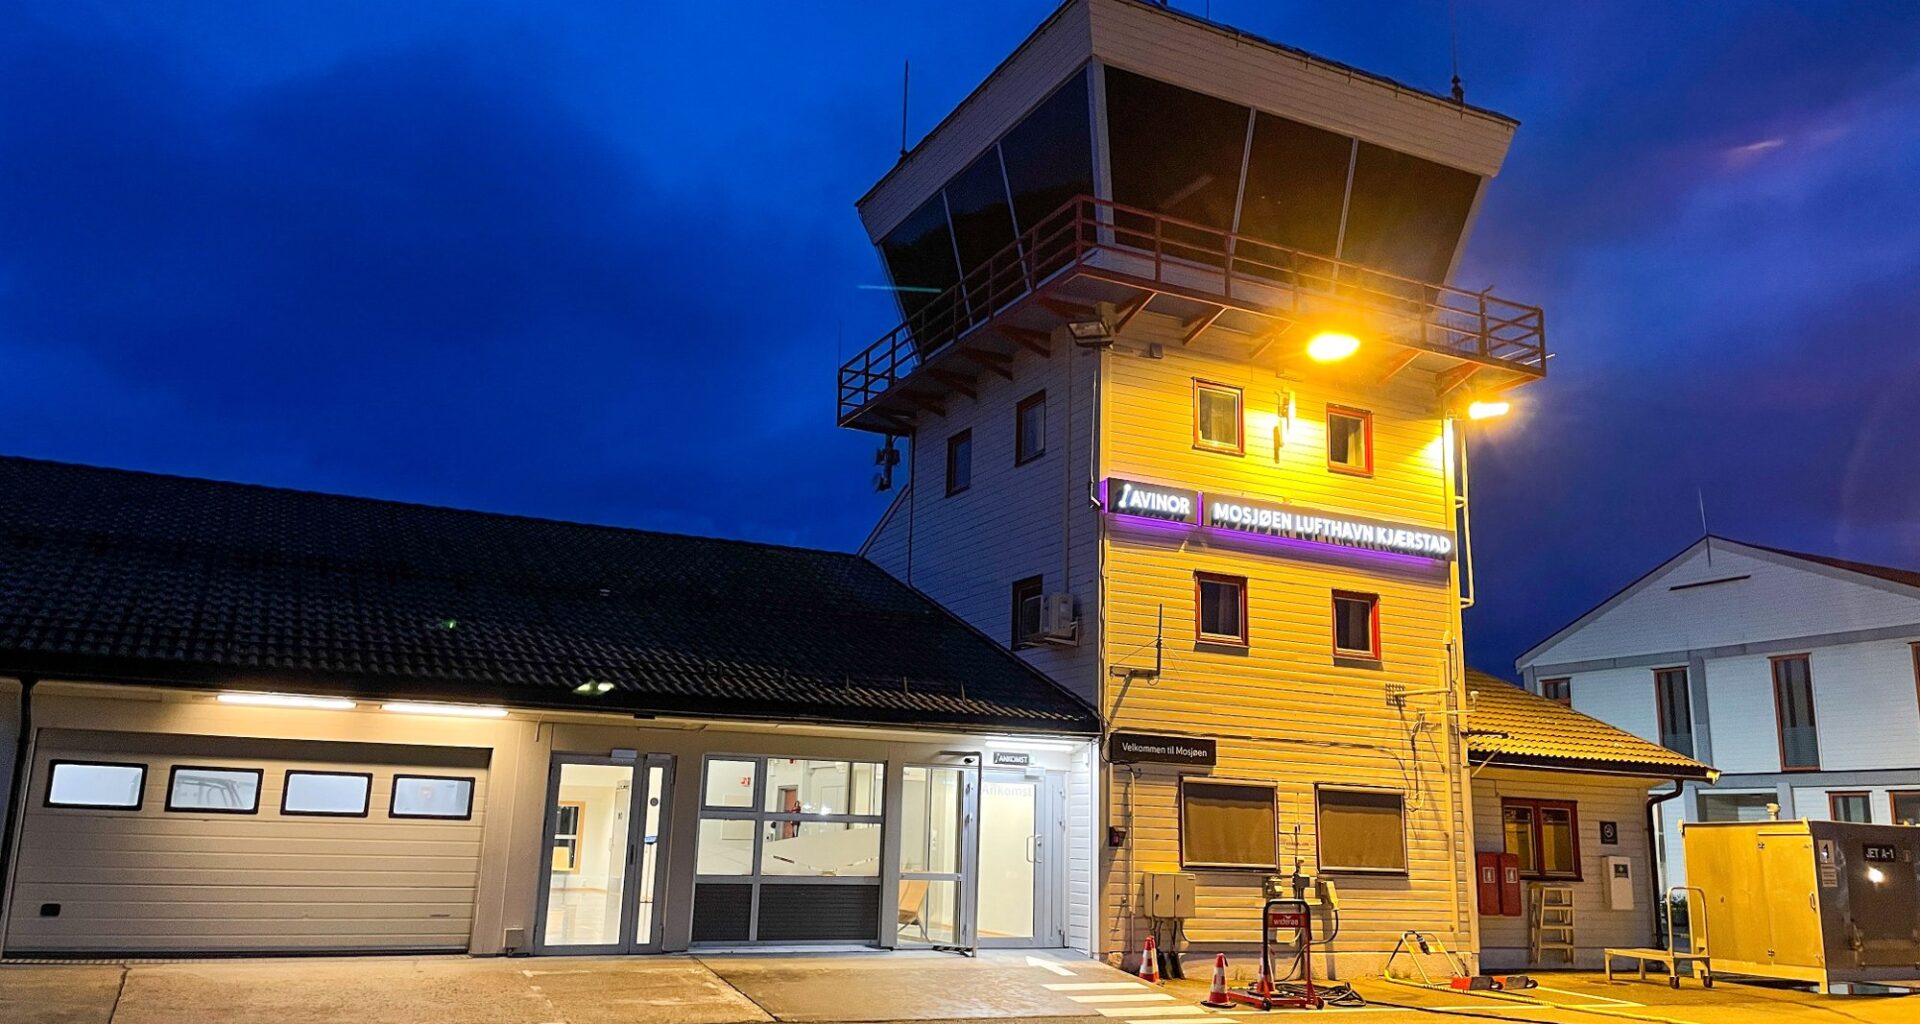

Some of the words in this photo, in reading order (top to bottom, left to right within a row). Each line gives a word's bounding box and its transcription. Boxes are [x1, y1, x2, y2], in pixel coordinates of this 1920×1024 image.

[1130, 489, 1190, 515] AVINOR
[1213, 502, 1292, 530] MOSJØEN
[1295, 515, 1374, 543] LUFTHAVN
[1376, 527, 1451, 554] KJÆRSTAD
[1122, 742, 1166, 754] Velkommen
[1176, 746, 1208, 758] Mosjøen
[998, 754, 1028, 764] ANKOMST
[1866, 848, 1879, 859] JET
[1881, 848, 1895, 859] A-1
